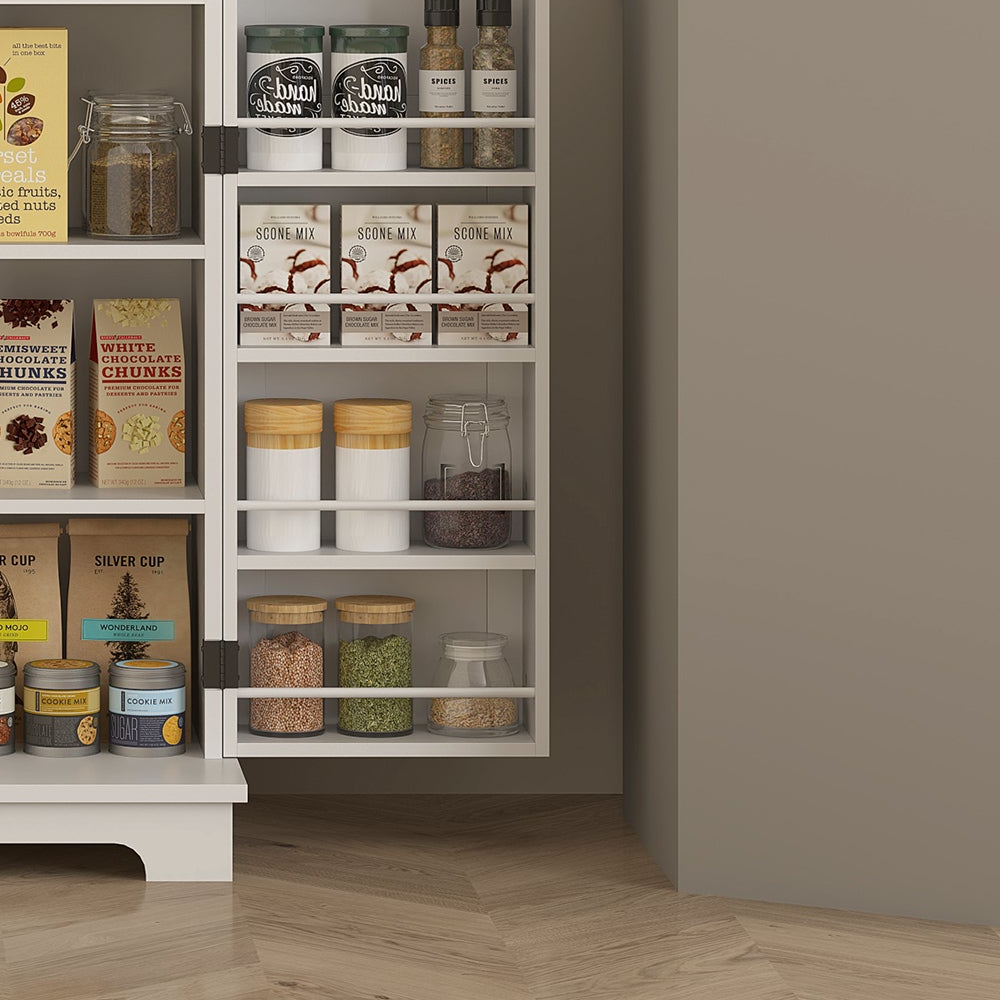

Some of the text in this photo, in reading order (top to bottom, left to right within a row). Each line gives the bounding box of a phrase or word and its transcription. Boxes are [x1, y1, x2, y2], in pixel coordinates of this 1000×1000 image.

[18, 186, 61, 199] fruits,
[24, 201, 56, 211] nuts
[256, 227, 315, 240] SCONE MIX
[358, 227, 417, 240] SCONE MIX
[454, 227, 513, 240] SCONE MIX
[101, 343, 156, 353] WHITE
[101, 355, 181, 364] CHOCOLATE
[101, 366, 182, 378] CHUNKS
[11, 555, 36, 566] CUP
[95, 555, 165, 567] SILVER CUP
[110, 714, 138, 740] SUGAR
